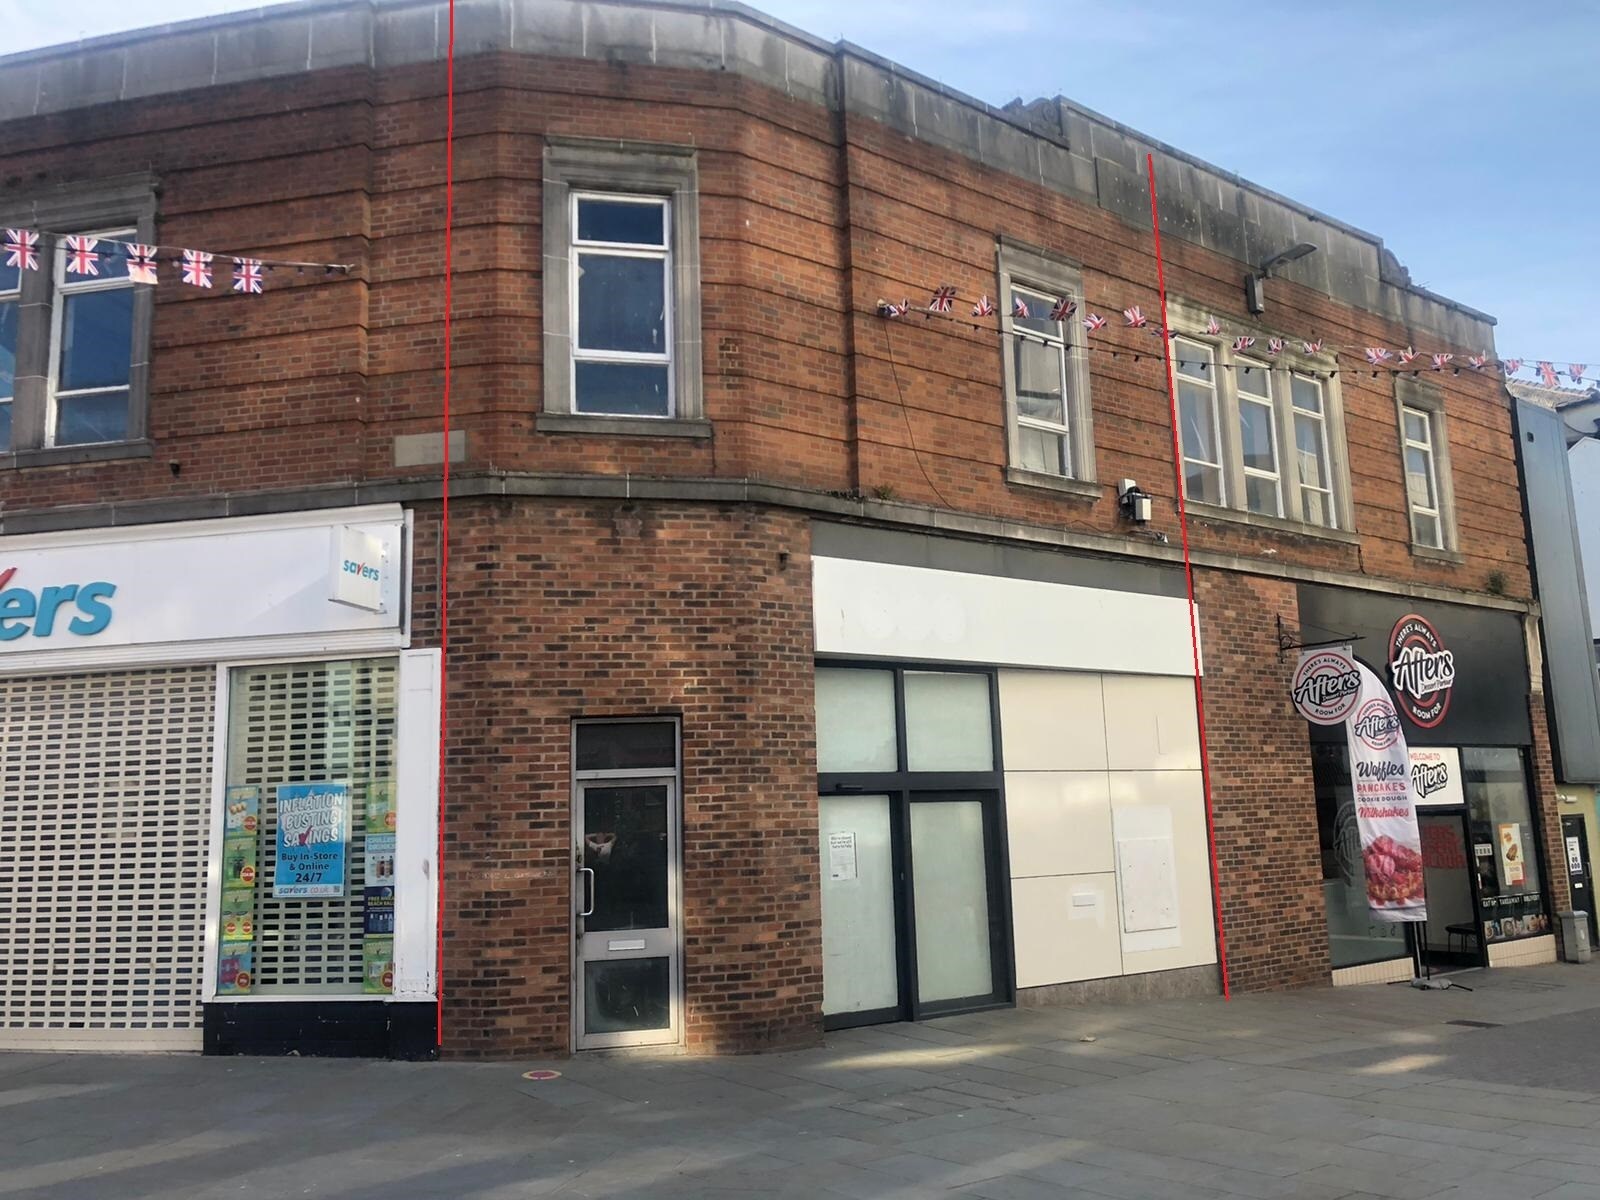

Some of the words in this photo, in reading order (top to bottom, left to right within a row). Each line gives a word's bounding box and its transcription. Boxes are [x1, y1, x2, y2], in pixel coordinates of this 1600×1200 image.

[343, 559, 380, 581] savers
[0, 567, 117, 641] ers
[1414, 623, 1437, 648] ALWAYS
[1323, 657, 1346, 670] ALWAYS
[1393, 648, 1454, 699] Afters
[1294, 670, 1361, 706] Afters
[1315, 707, 1334, 716] ROOM
[1334, 703, 1346, 713] FOR
[1412, 705, 1431, 719] ROOM
[1431, 702, 1442, 717] FOR
[1354, 714, 1400, 739] Afters
[1356, 761, 1405, 781] Waffles
[1411, 762, 1449, 799] Afters
[1356, 782, 1406, 792] PANCAKES
[280, 792, 344, 813] INFLATION
[1358, 806, 1409, 818] Milkshakes
[286, 809, 339, 831] BUSTING
[283, 826, 338, 847] SAVINGS
[281, 853, 298, 862] Buy
[300, 852, 338, 860] In-Store
[289, 863, 296, 871] &
[298, 862, 330, 871] Online
[295, 872, 322, 883] 24/7
